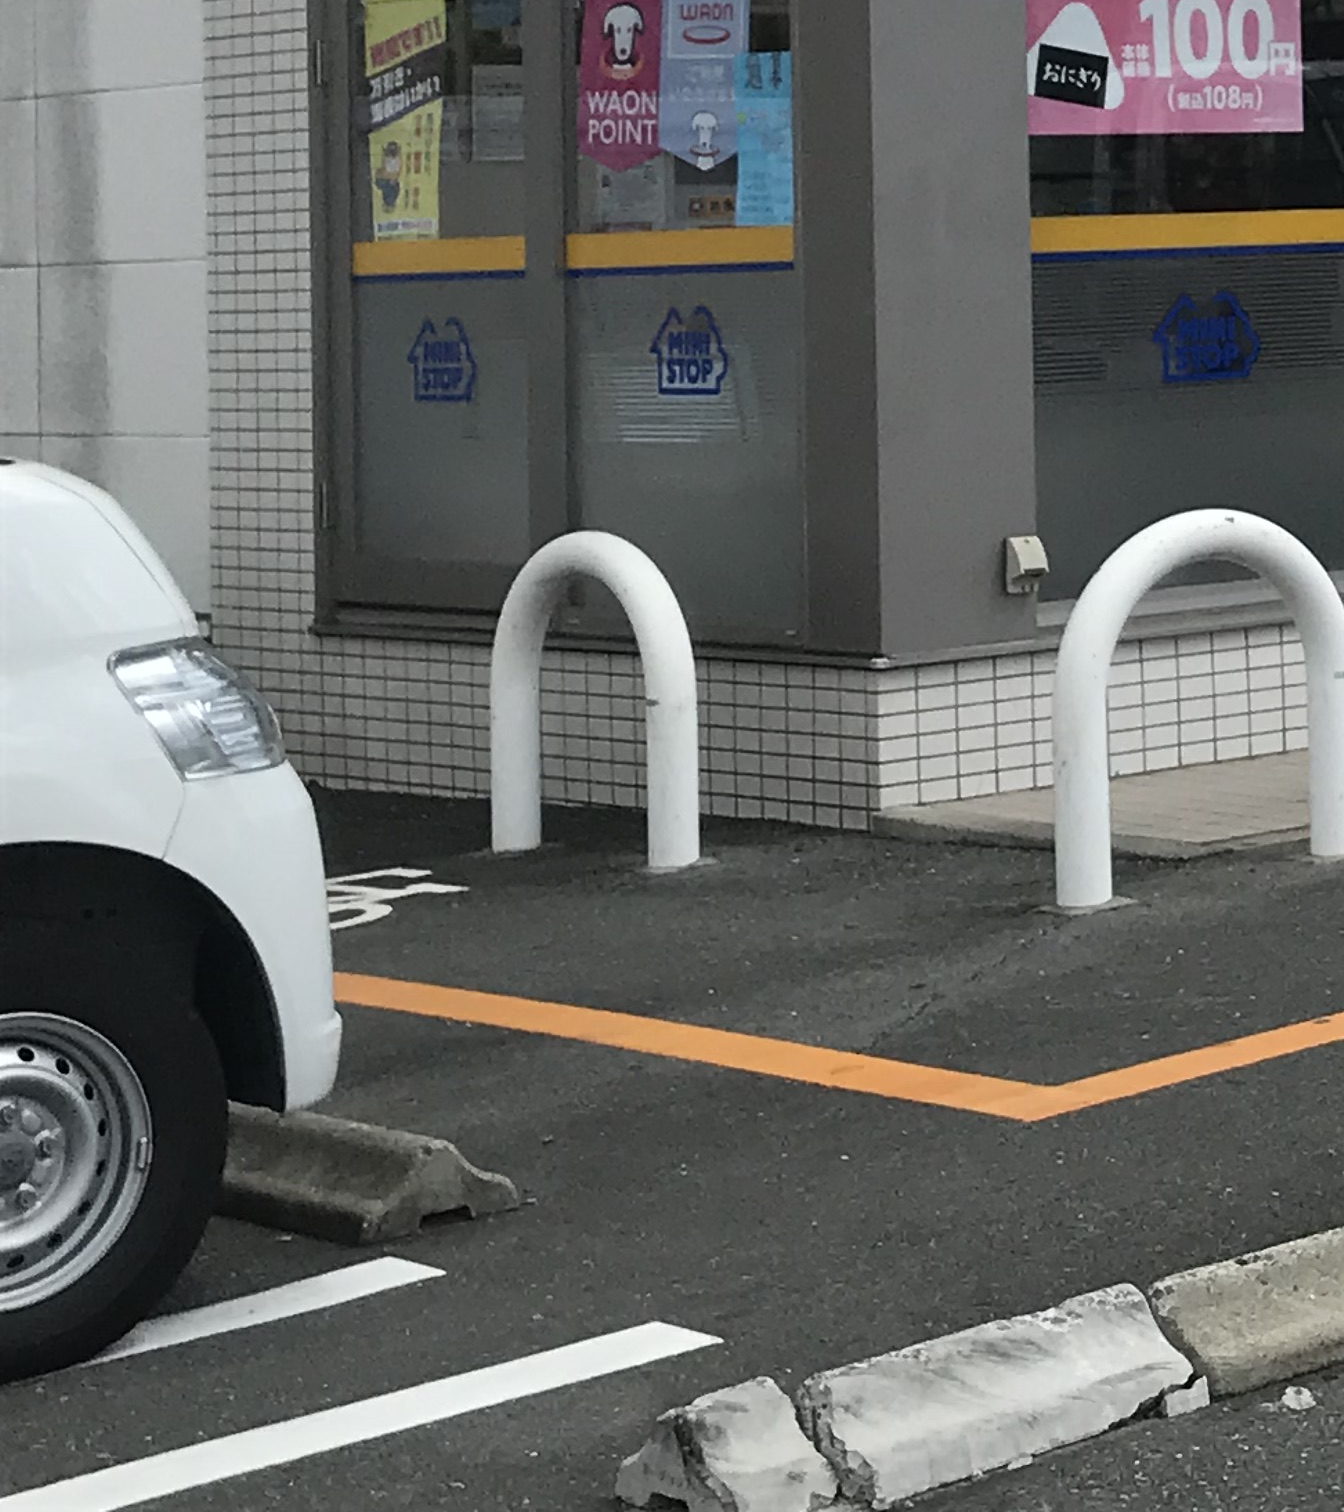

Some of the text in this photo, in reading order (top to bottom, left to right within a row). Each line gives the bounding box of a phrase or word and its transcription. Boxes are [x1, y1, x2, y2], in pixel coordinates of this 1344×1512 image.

[680, 2, 735, 22] WAON
[1042, 61, 1101, 92] おにぎり
[585, 89, 658, 115] WAON
[587, 119, 658, 145] POINT
[666, 330, 711, 355] MINI
[1177, 315, 1237, 344] MINI
[1174, 343, 1241, 371] STOP
[665, 357, 714, 385] STOP
